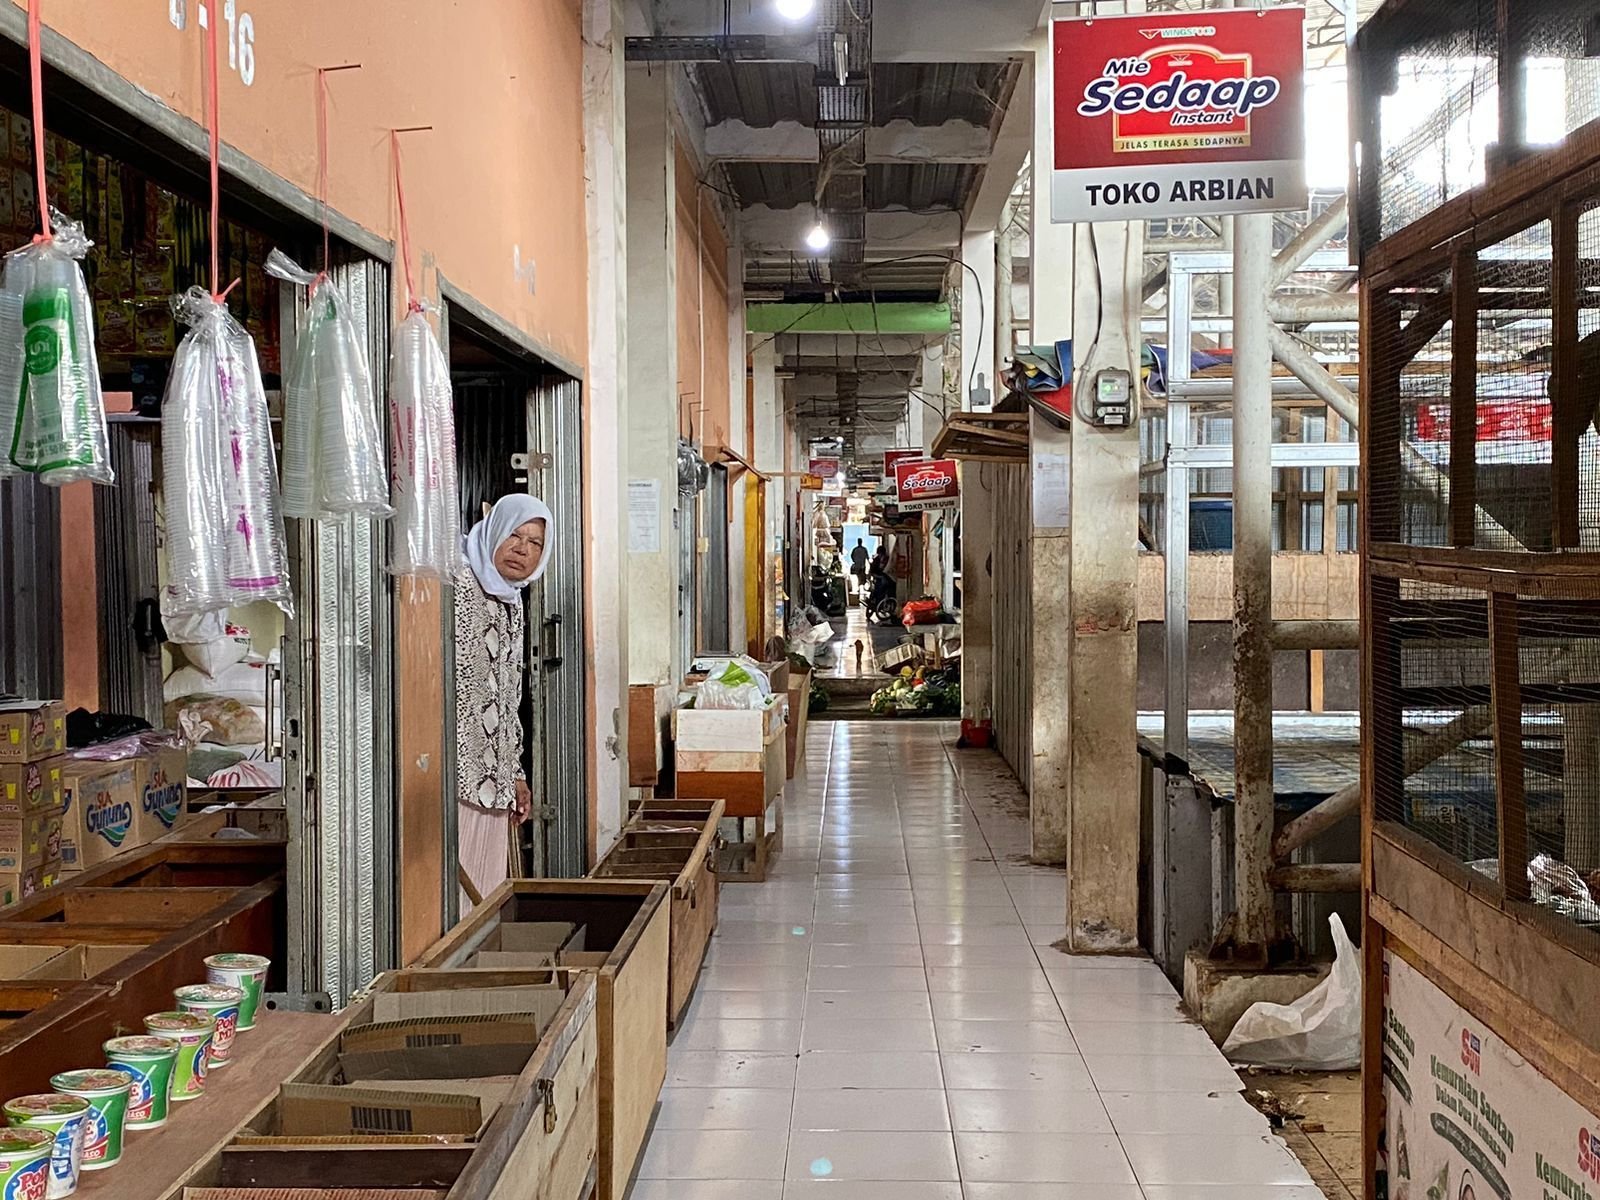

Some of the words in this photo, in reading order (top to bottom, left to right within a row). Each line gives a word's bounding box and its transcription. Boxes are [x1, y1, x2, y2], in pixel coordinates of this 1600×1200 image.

[1106, 58, 1149, 75] Mie
[1080, 74, 1277, 114] Sedaap
[1172, 111, 1234, 125] Instant
[1119, 141, 1149, 151] JELAS
[1153, 138, 1189, 149] TERASA
[1193, 135, 1245, 147] SEDAPNYA
[1085, 183, 1161, 206] TOKO
[1169, 177, 1275, 202] ARBIAN
[902, 476, 952, 489] Sedaap
[904, 503, 923, 511] TOKO
[1389, 1007, 1415, 1058] Santan
[1430, 1054, 1479, 1110] Kemurnian
[1480, 1091, 1514, 1154] Santan
[1435, 1083, 1458, 1113] Dalam
[1458, 1098, 1473, 1127] Dua
[1473, 1111, 1507, 1169] Kemasan
